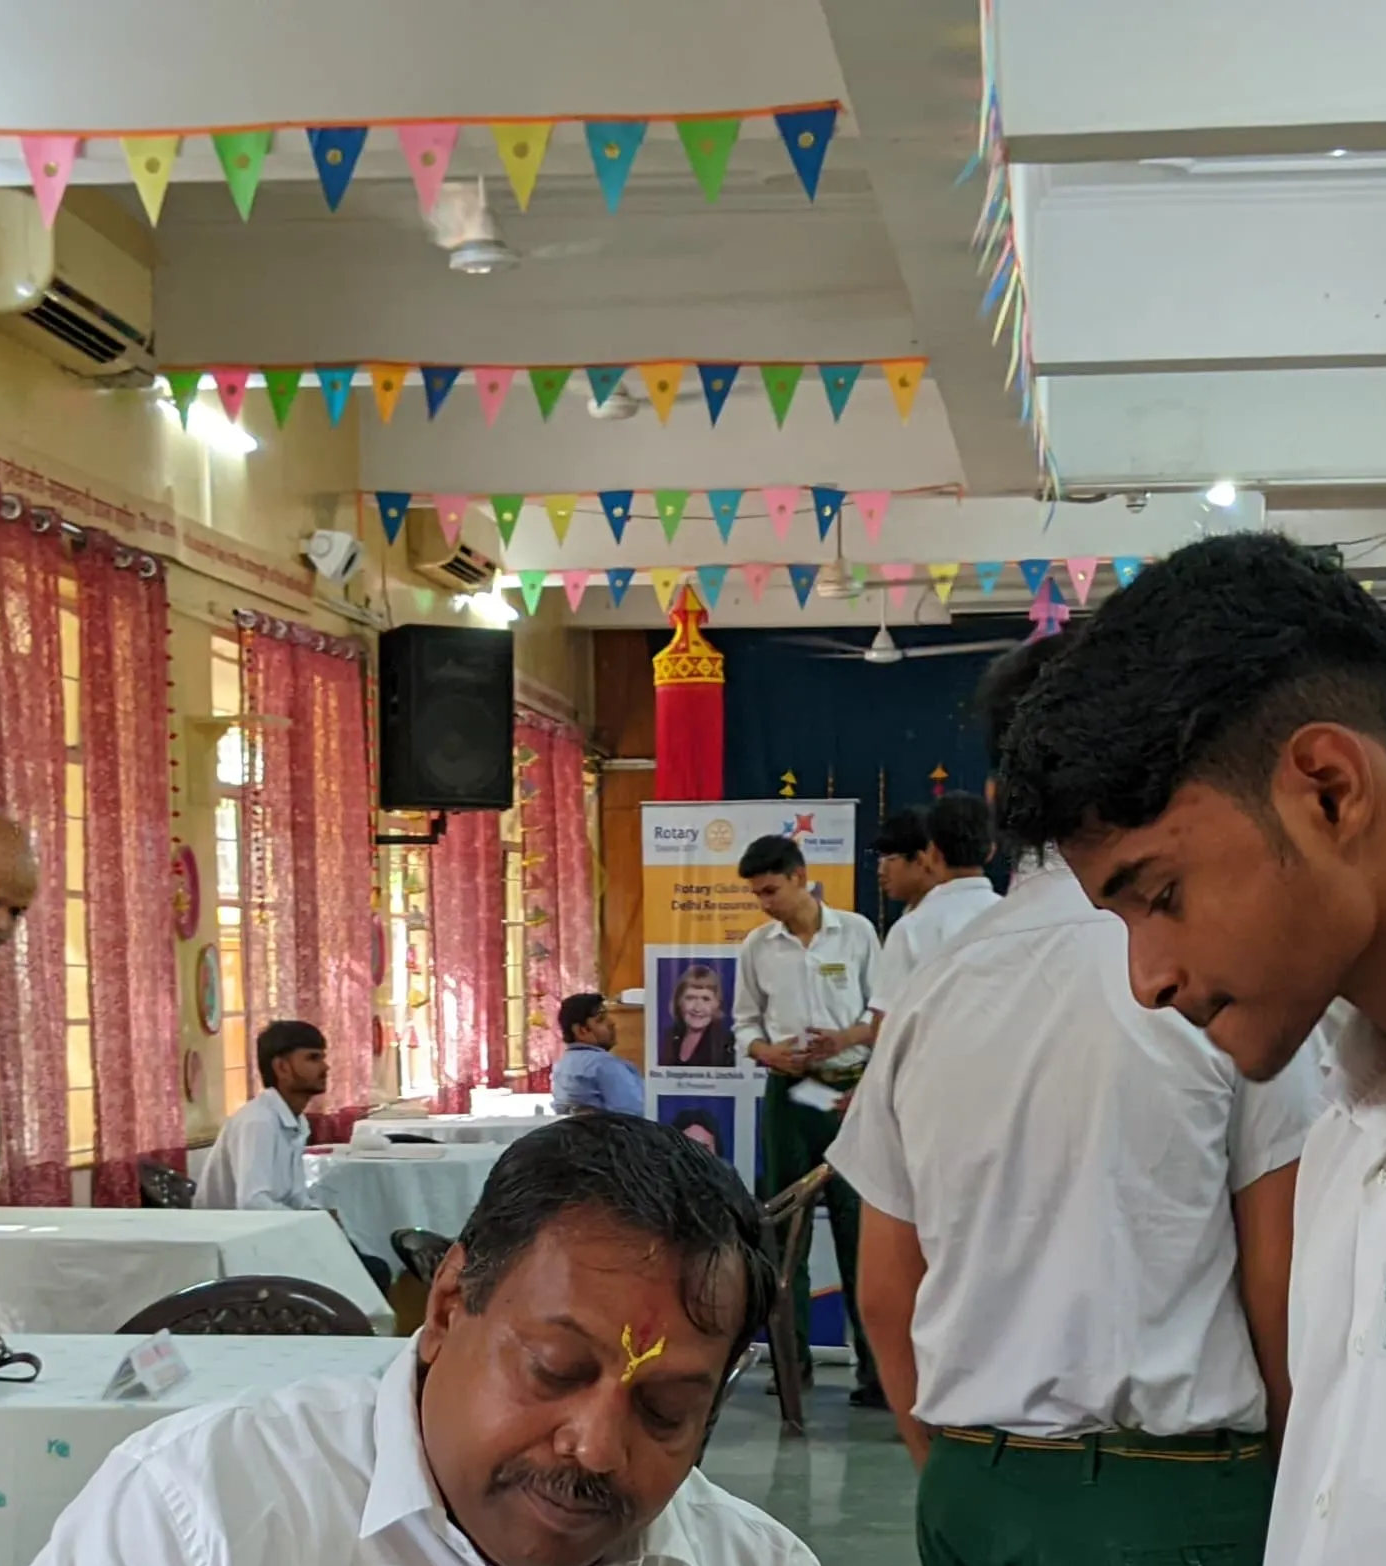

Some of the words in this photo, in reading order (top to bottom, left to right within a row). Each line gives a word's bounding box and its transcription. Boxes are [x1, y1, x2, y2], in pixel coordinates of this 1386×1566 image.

[654, 826, 700, 843] Rotary
[674, 882, 711, 897] Rotary
[671, 899, 702, 912] Delhi
